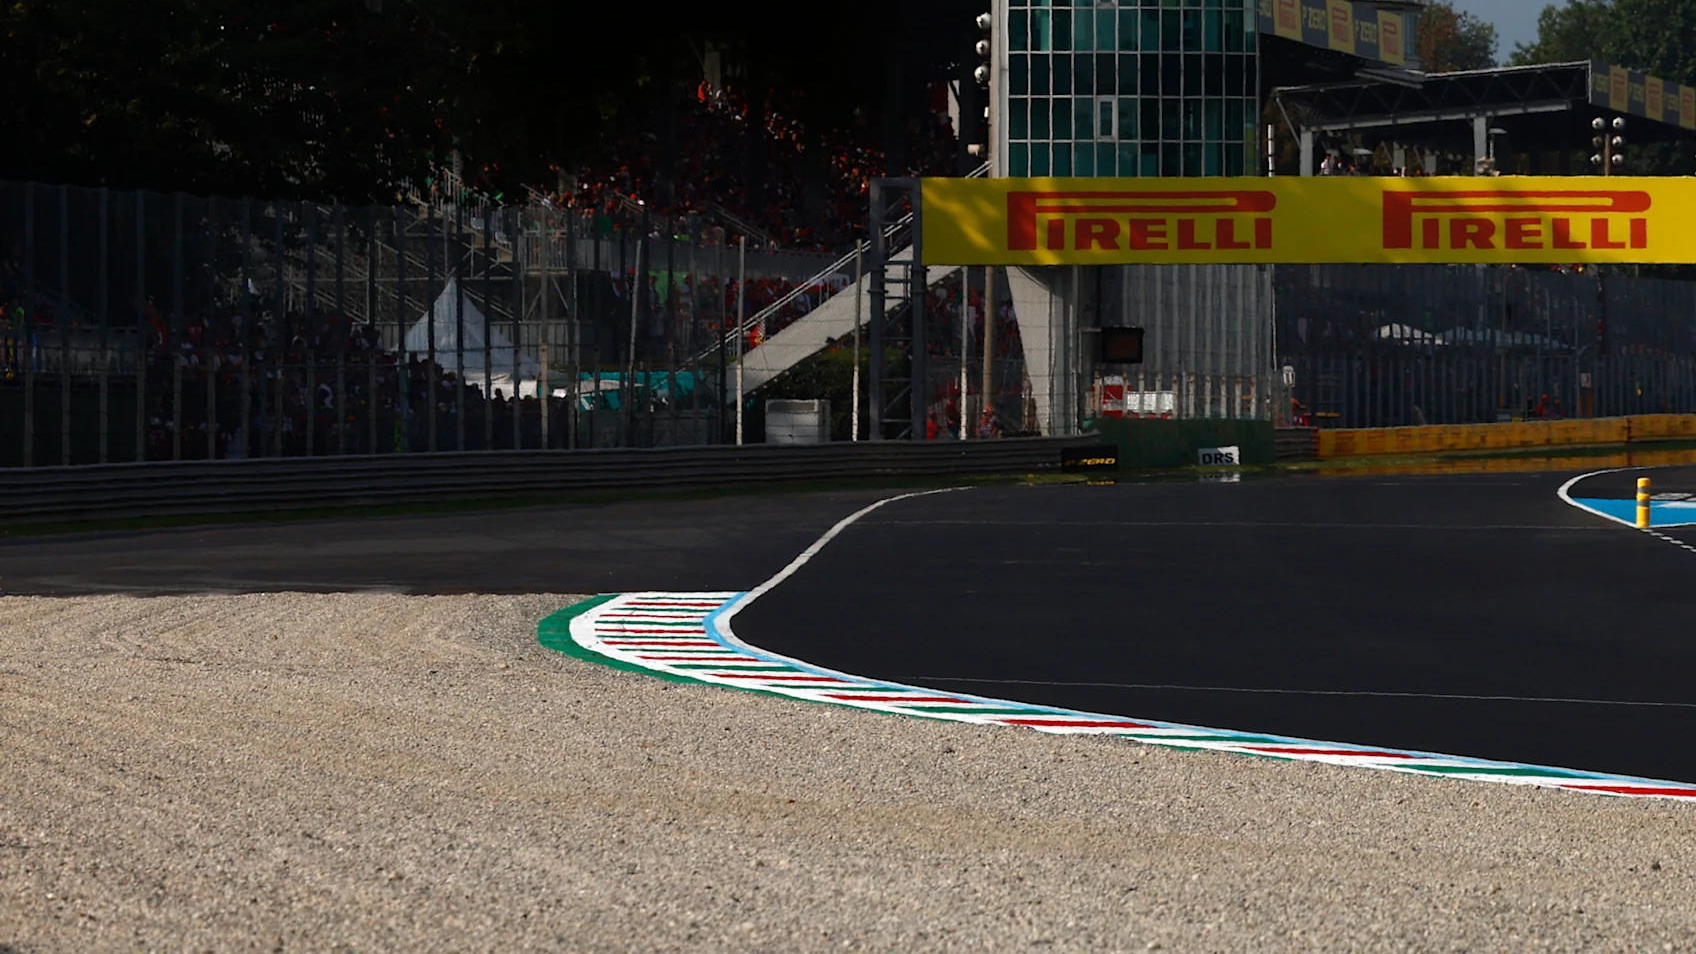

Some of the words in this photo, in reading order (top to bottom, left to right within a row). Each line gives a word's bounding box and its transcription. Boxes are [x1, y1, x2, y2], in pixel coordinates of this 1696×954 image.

[1007, 190, 1277, 250] PIRELLI
[1382, 190, 1651, 250] PIRELLI
[1202, 453, 1234, 464] DRS
